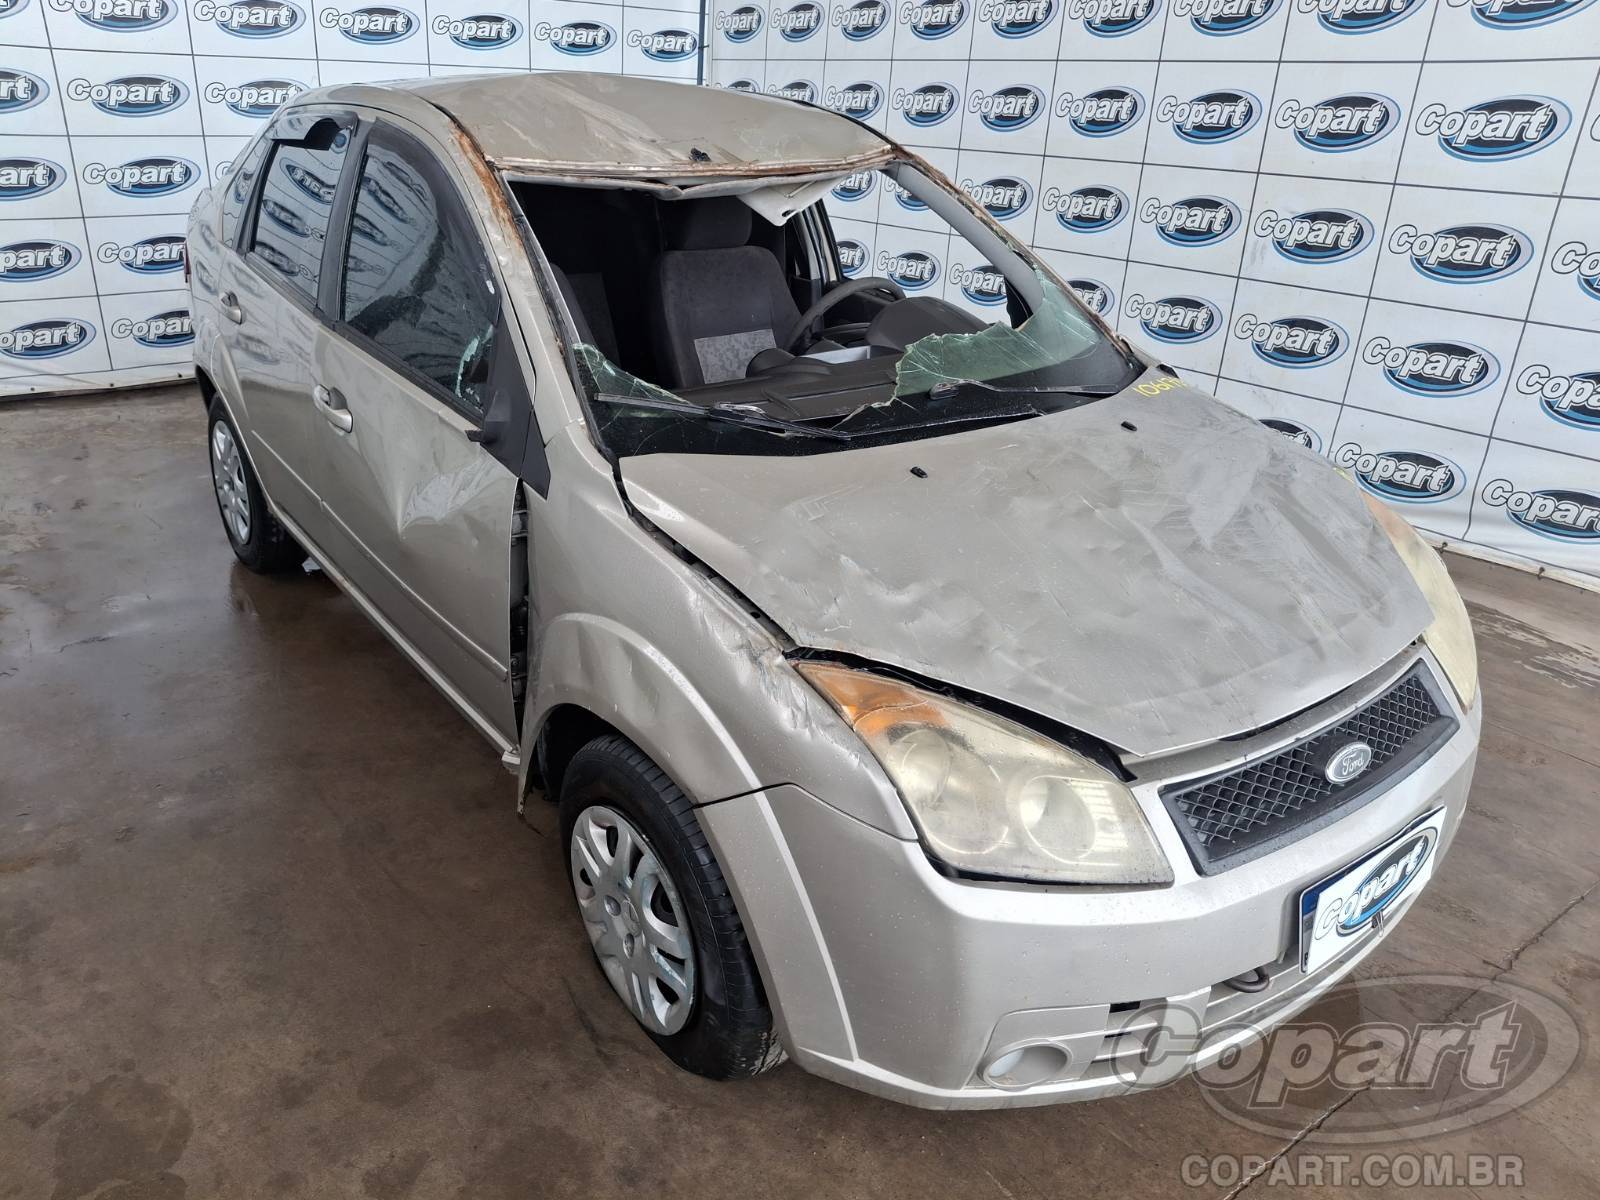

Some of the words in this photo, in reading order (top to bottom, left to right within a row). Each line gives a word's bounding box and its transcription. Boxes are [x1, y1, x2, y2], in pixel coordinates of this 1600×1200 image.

[194, 0, 292, 28] Copart
[320, 7, 408, 34] Copart
[432, 15, 513, 39] Copart
[715, 10, 761, 34] Copart
[770, 8, 819, 33] Copart
[832, 4, 885, 32] Copart
[900, 1, 964, 34] Copart
[979, 0, 1048, 28] Copart
[1068, 0, 1153, 26] Copart
[535, 22, 607, 47] Copart
[627, 30, 695, 54] Copart
[67, 78, 174, 108] Copart
[825, 86, 878, 112] Copart
[892, 87, 954, 115] Copart
[968, 89, 1039, 120] Copart
[1055, 92, 1135, 125] Copart
[1156, 95, 1250, 131] Copart
[1275, 99, 1386, 138] Copart
[1415, 103, 1553, 146] Copart
[83, 162, 185, 190] Copart
[1042, 187, 1121, 219] Copart
[1140, 197, 1231, 232] Copart
[1253, 209, 1359, 249] Copart
[1389, 224, 1516, 267] Copart
[877, 250, 933, 280] Copart
[1125, 293, 1212, 332] Copart
[1234, 313, 1336, 356] Copart
[1362, 336, 1485, 384] Copart
[1334, 442, 1453, 493] Copart
[1342, 752, 1364, 775] Ford
[1315, 834, 1426, 940] Copart
